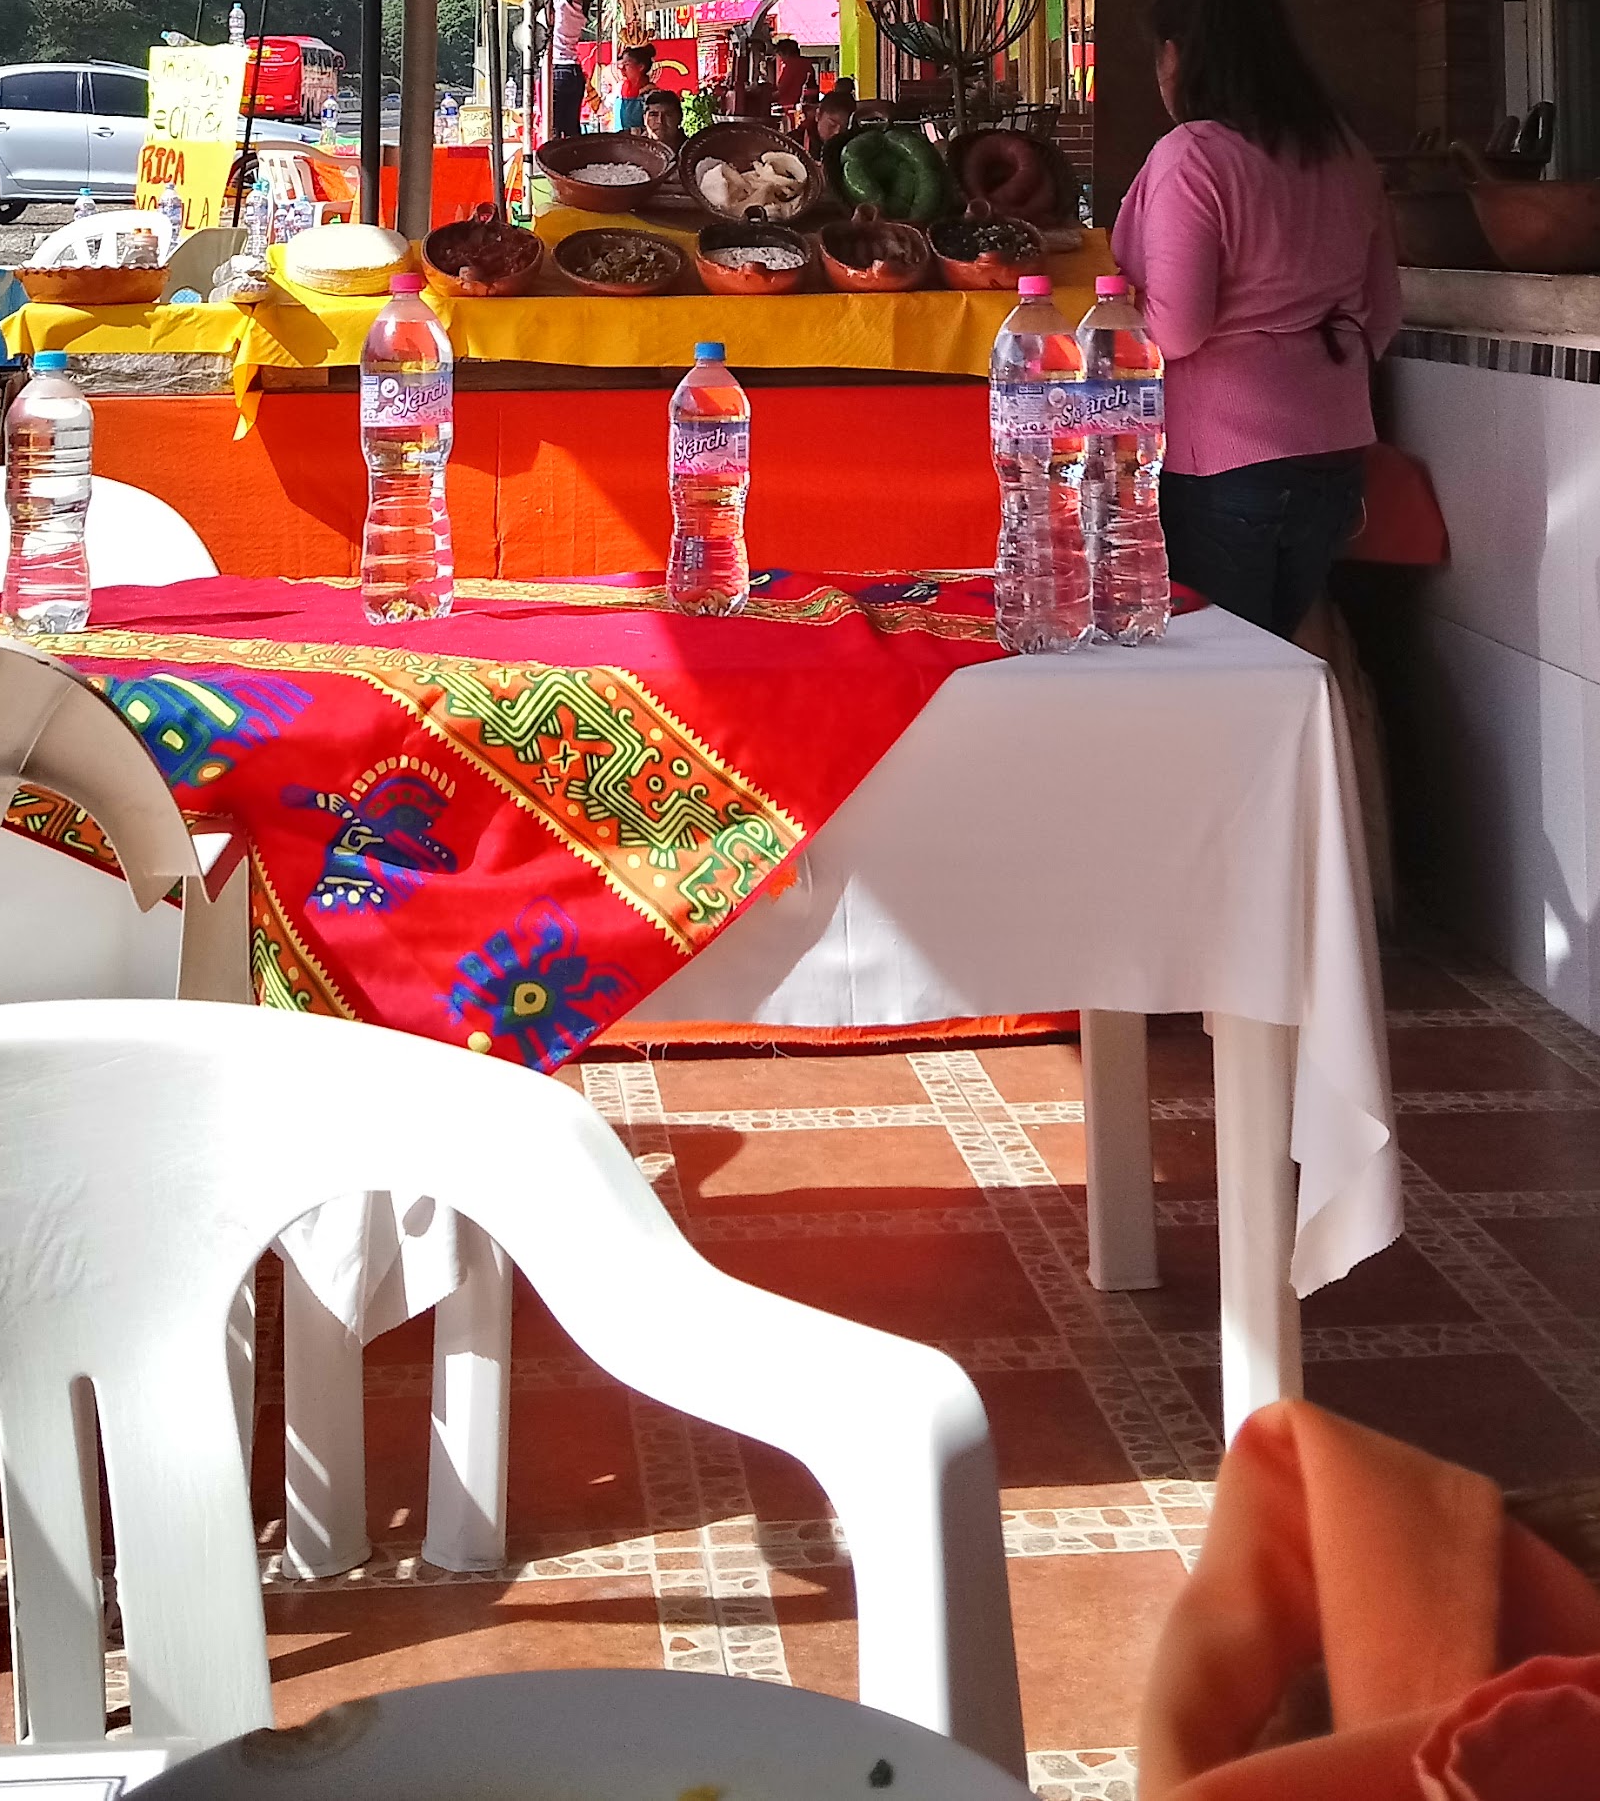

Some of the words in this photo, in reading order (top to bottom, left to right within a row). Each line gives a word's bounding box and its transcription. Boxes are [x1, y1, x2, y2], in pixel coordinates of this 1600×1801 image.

[140, 145, 185, 187] RICA
[391, 375, 448, 419] Skarch
[672, 426, 729, 463] Skarch
